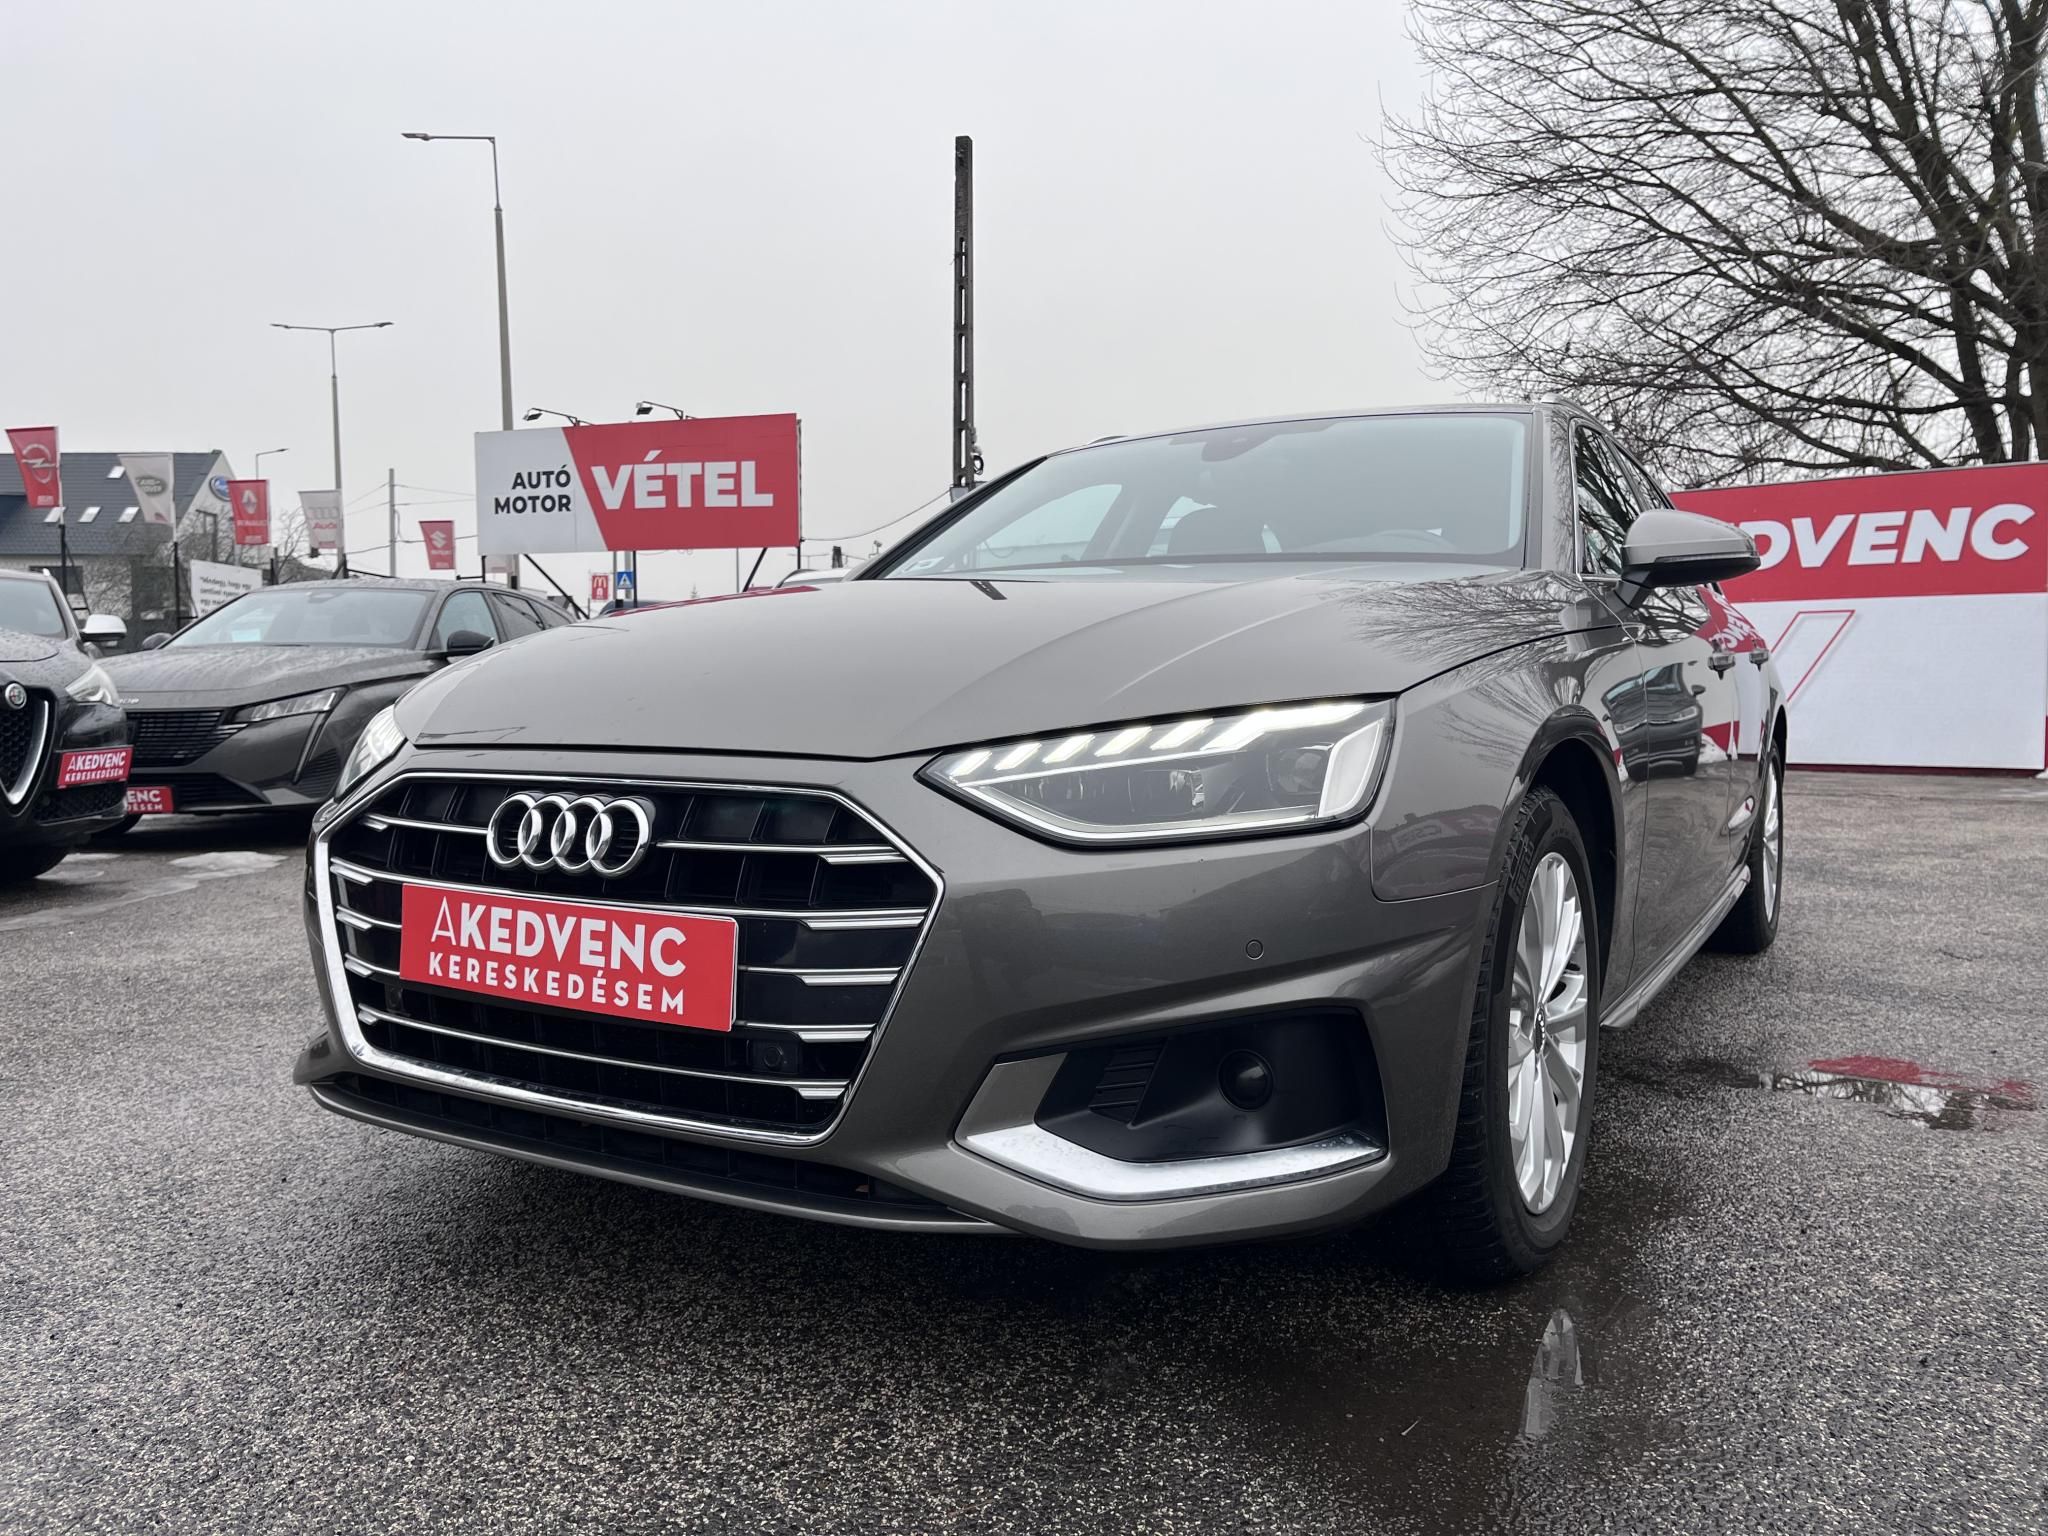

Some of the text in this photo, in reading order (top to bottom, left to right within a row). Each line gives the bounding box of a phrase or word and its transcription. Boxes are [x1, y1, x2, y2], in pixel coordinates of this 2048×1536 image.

[494, 494, 571, 515] MOTOR
[511, 464, 571, 491] AUTÓ
[591, 450, 774, 510] VÉTEL
[1733, 504, 2037, 571] DVENC
[67, 752, 126, 771] AKEDVENC
[430, 895, 686, 978] AKEDVENC
[429, 951, 684, 1016] KERESKEDÉSEM
